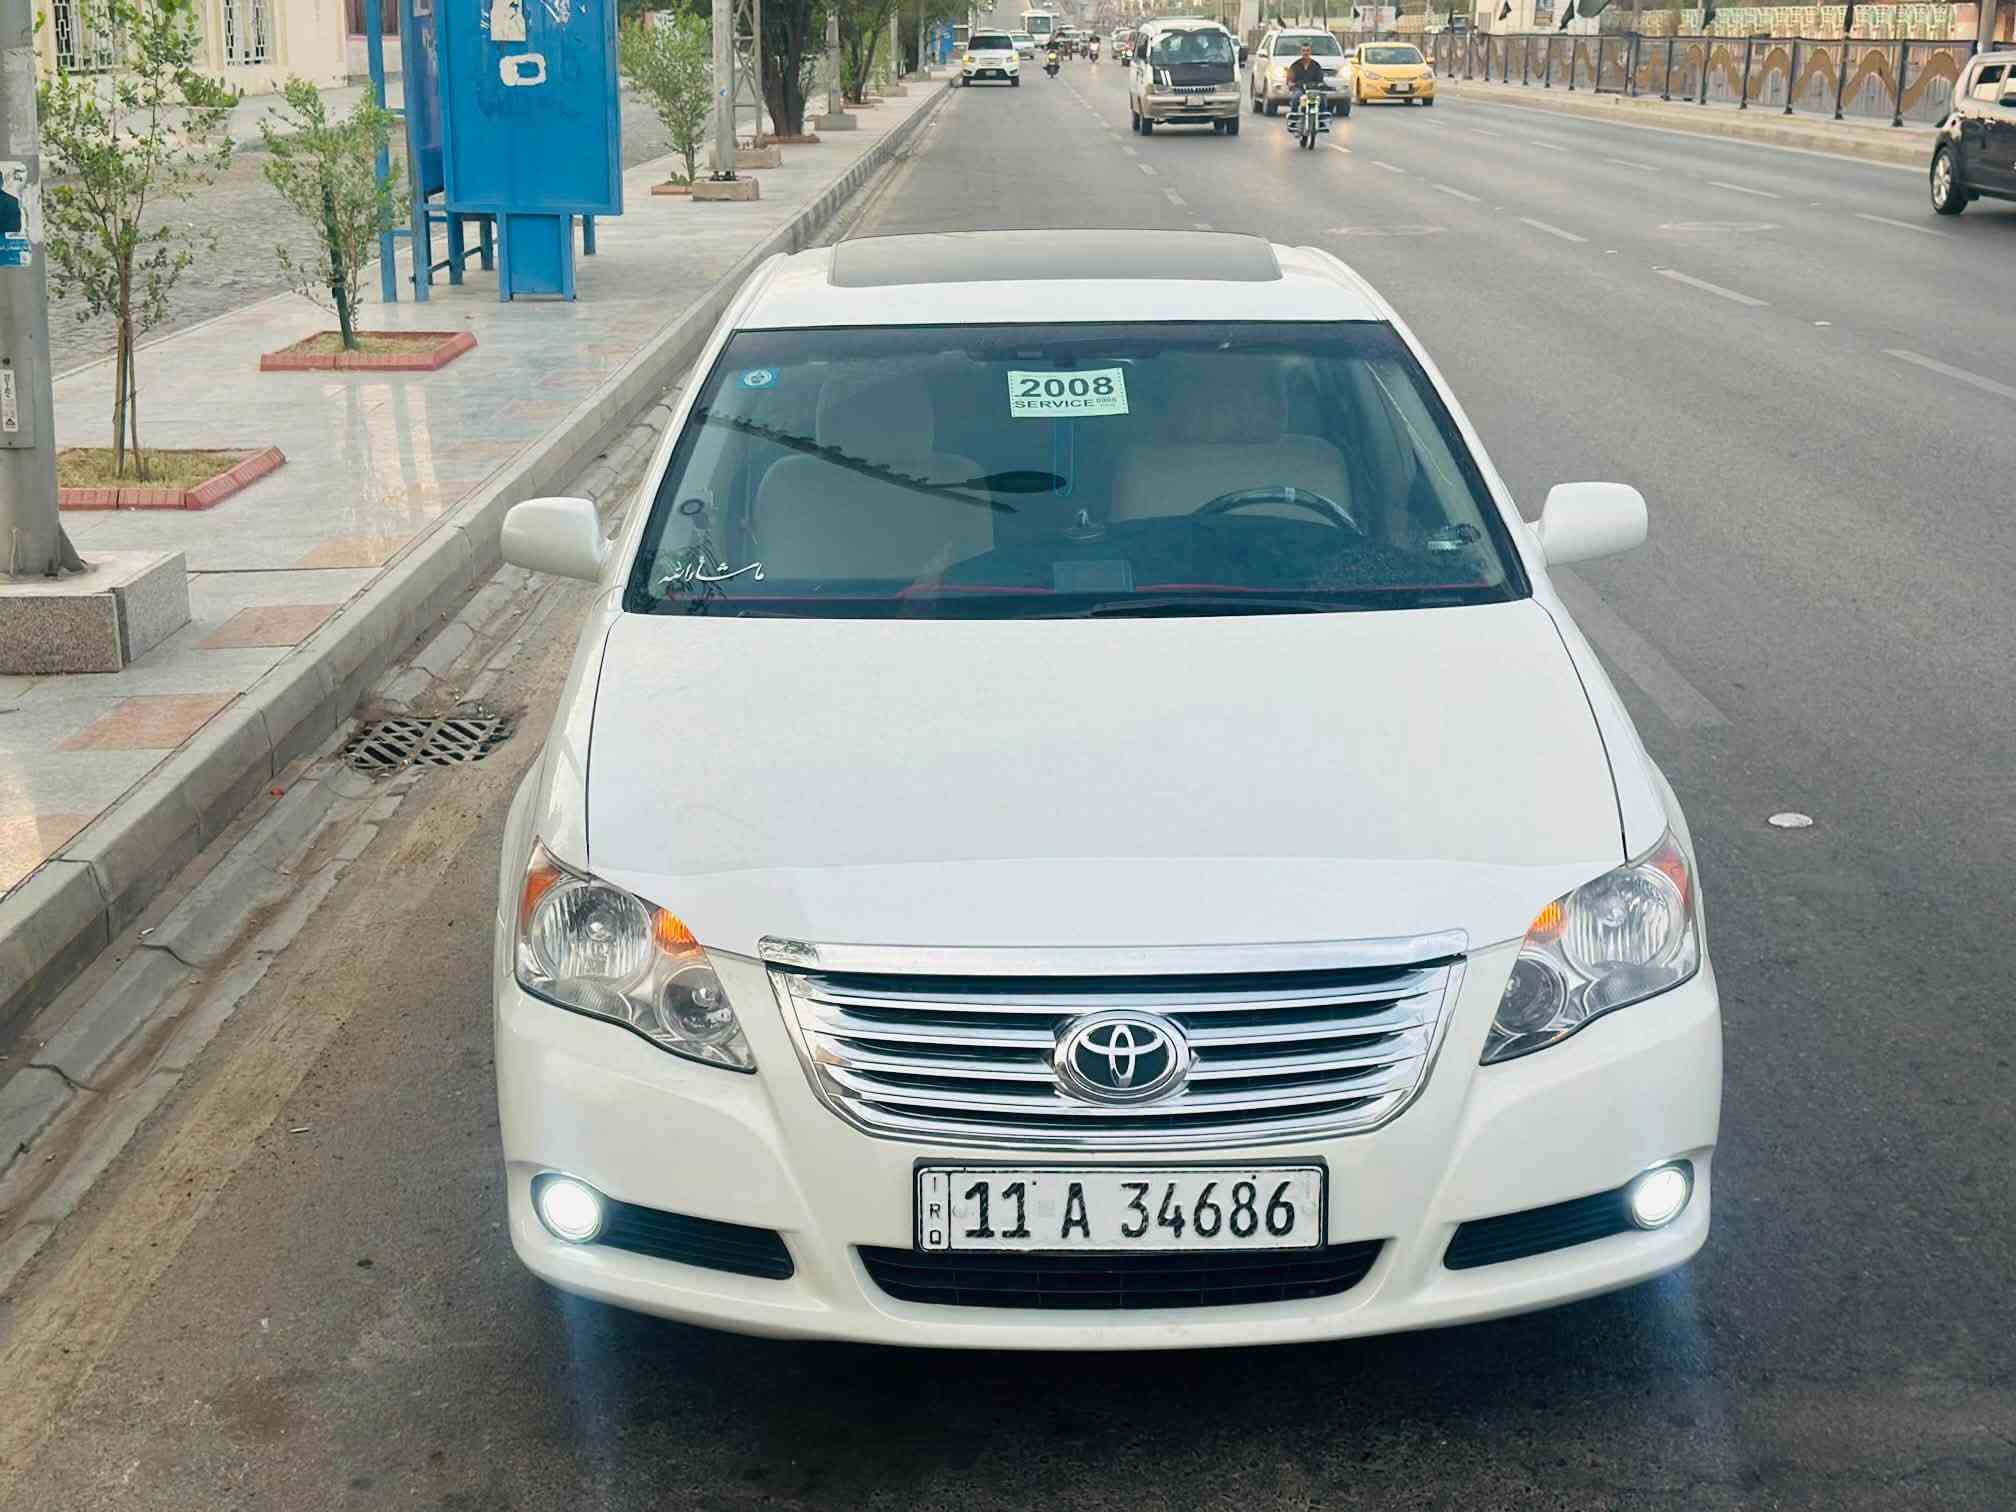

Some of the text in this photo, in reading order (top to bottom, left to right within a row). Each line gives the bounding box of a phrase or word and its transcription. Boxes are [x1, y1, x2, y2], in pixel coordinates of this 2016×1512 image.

[1018, 377, 1114, 397] 2008
[1015, 399, 1094, 409] SERVICE
[964, 1182, 1296, 1239] 11 A 34686
